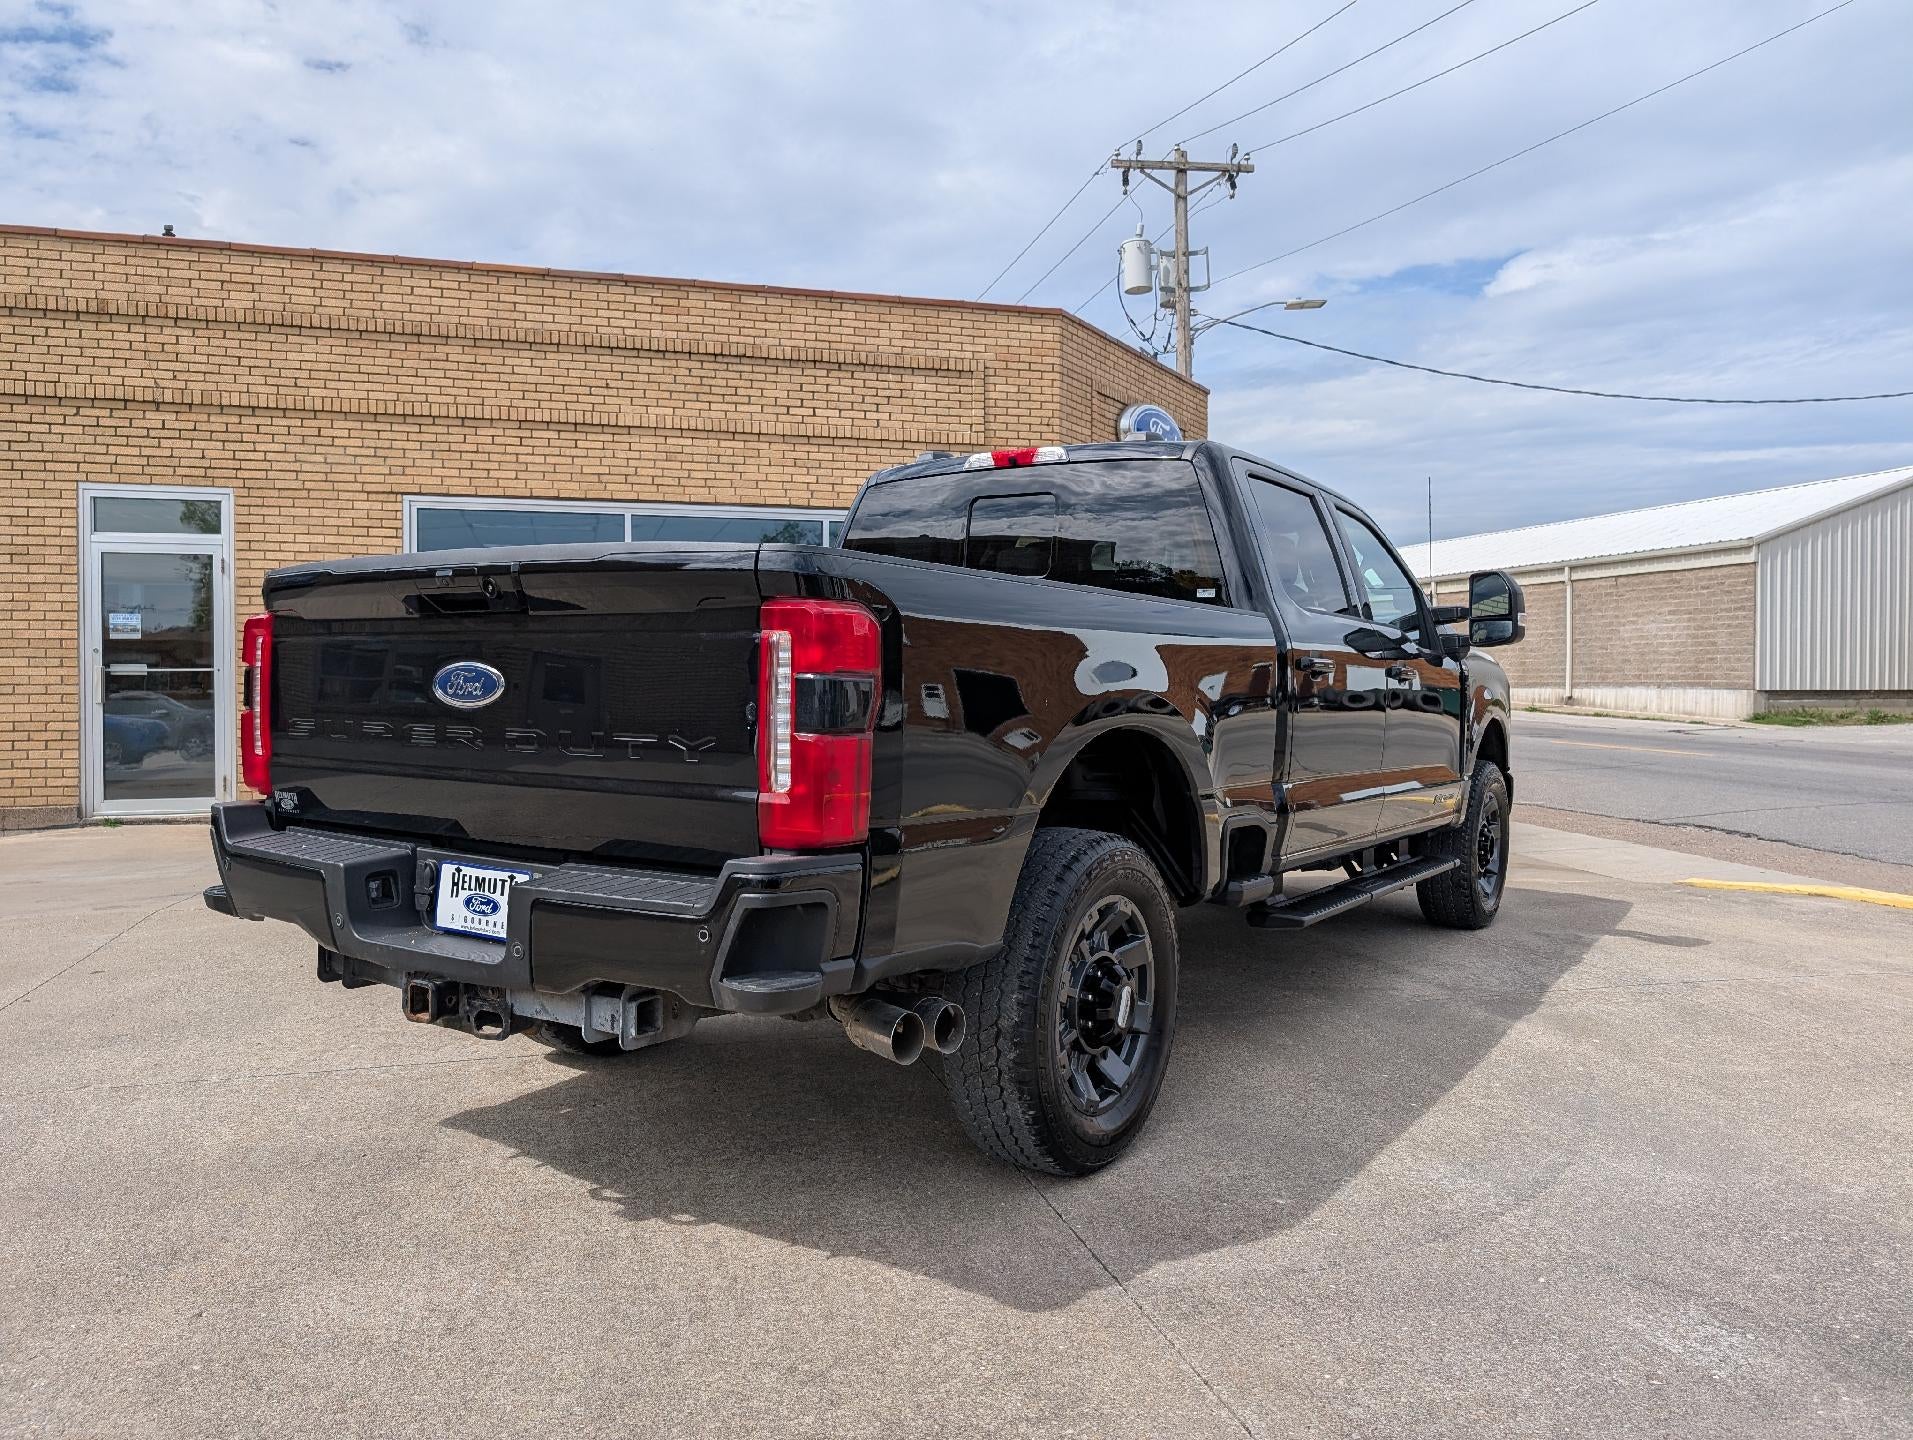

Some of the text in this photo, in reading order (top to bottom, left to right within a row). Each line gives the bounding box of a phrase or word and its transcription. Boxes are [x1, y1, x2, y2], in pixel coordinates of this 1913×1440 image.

[446, 670, 485, 696] Ford
[288, 718, 717, 762] SUPER DUTY
[469, 896, 494, 914] Ford
[451, 914, 505, 930] SIGOURNE
